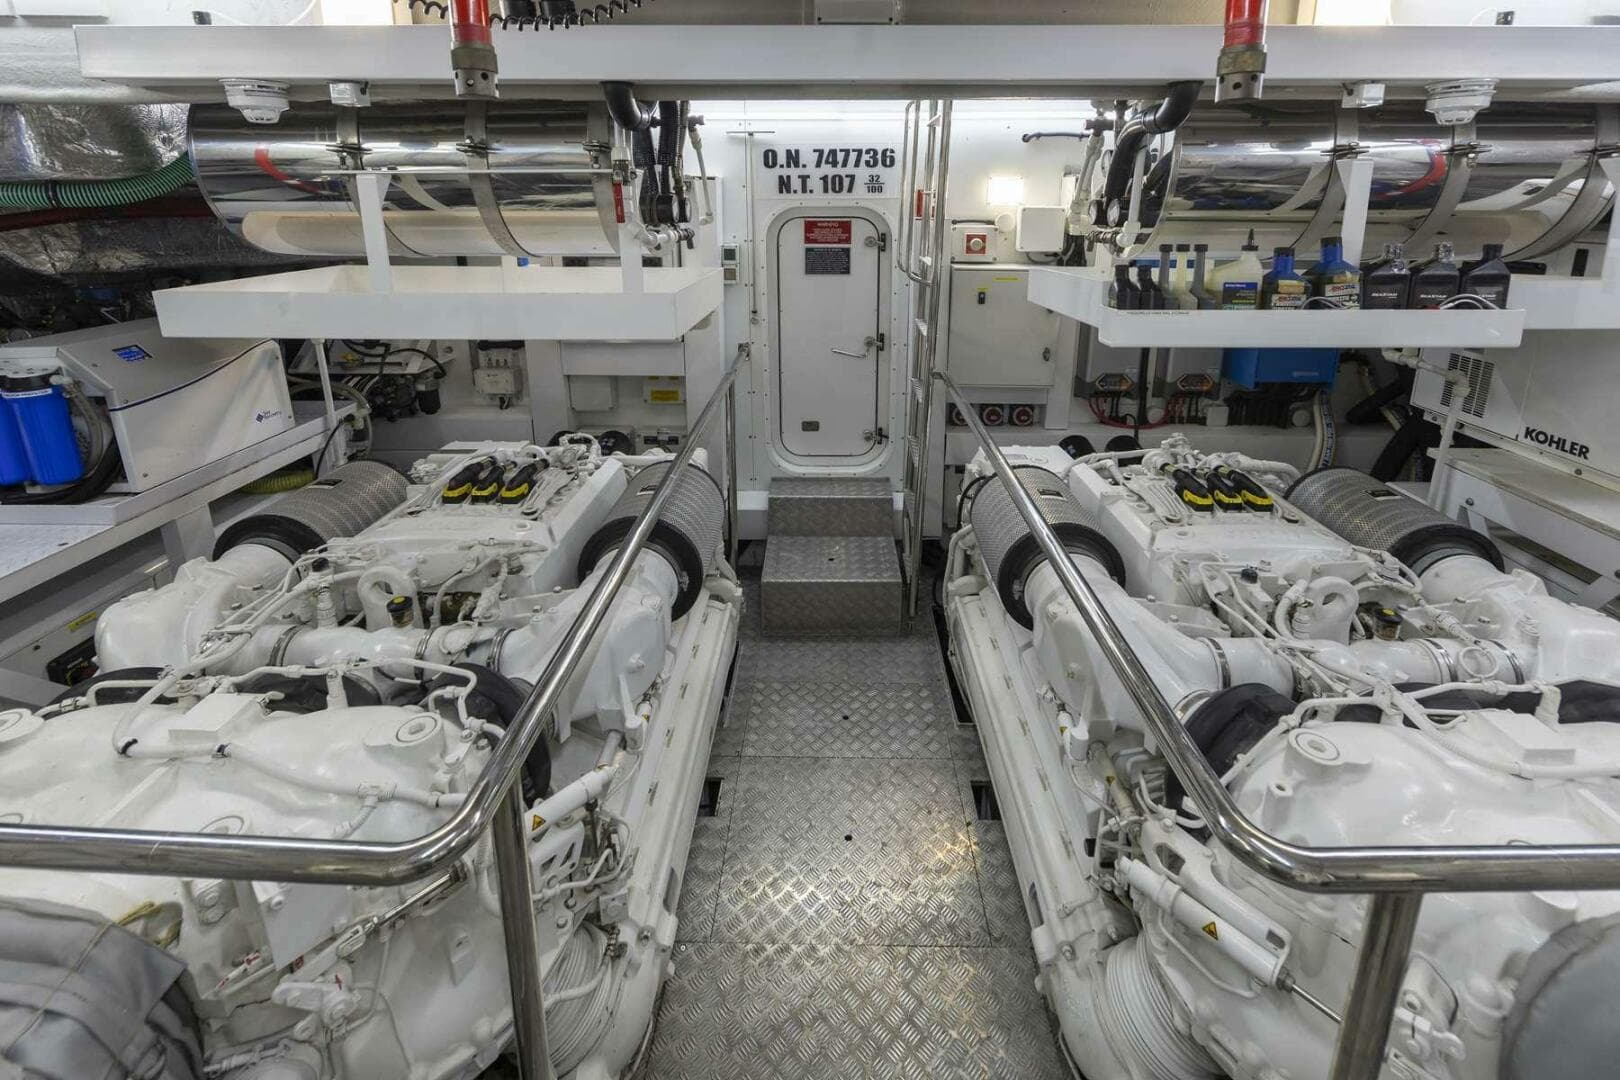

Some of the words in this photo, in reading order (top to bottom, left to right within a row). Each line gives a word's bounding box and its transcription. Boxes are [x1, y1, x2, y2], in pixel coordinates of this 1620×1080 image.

[763, 148, 808, 169] O.N.
[812, 148, 896, 168] 747736
[778, 174, 815, 194] N.T.
[818, 174, 856, 194] 107
[867, 174, 881, 183] 32
[866, 185, 883, 194] 100
[1524, 426, 1590, 460] KOHLER
